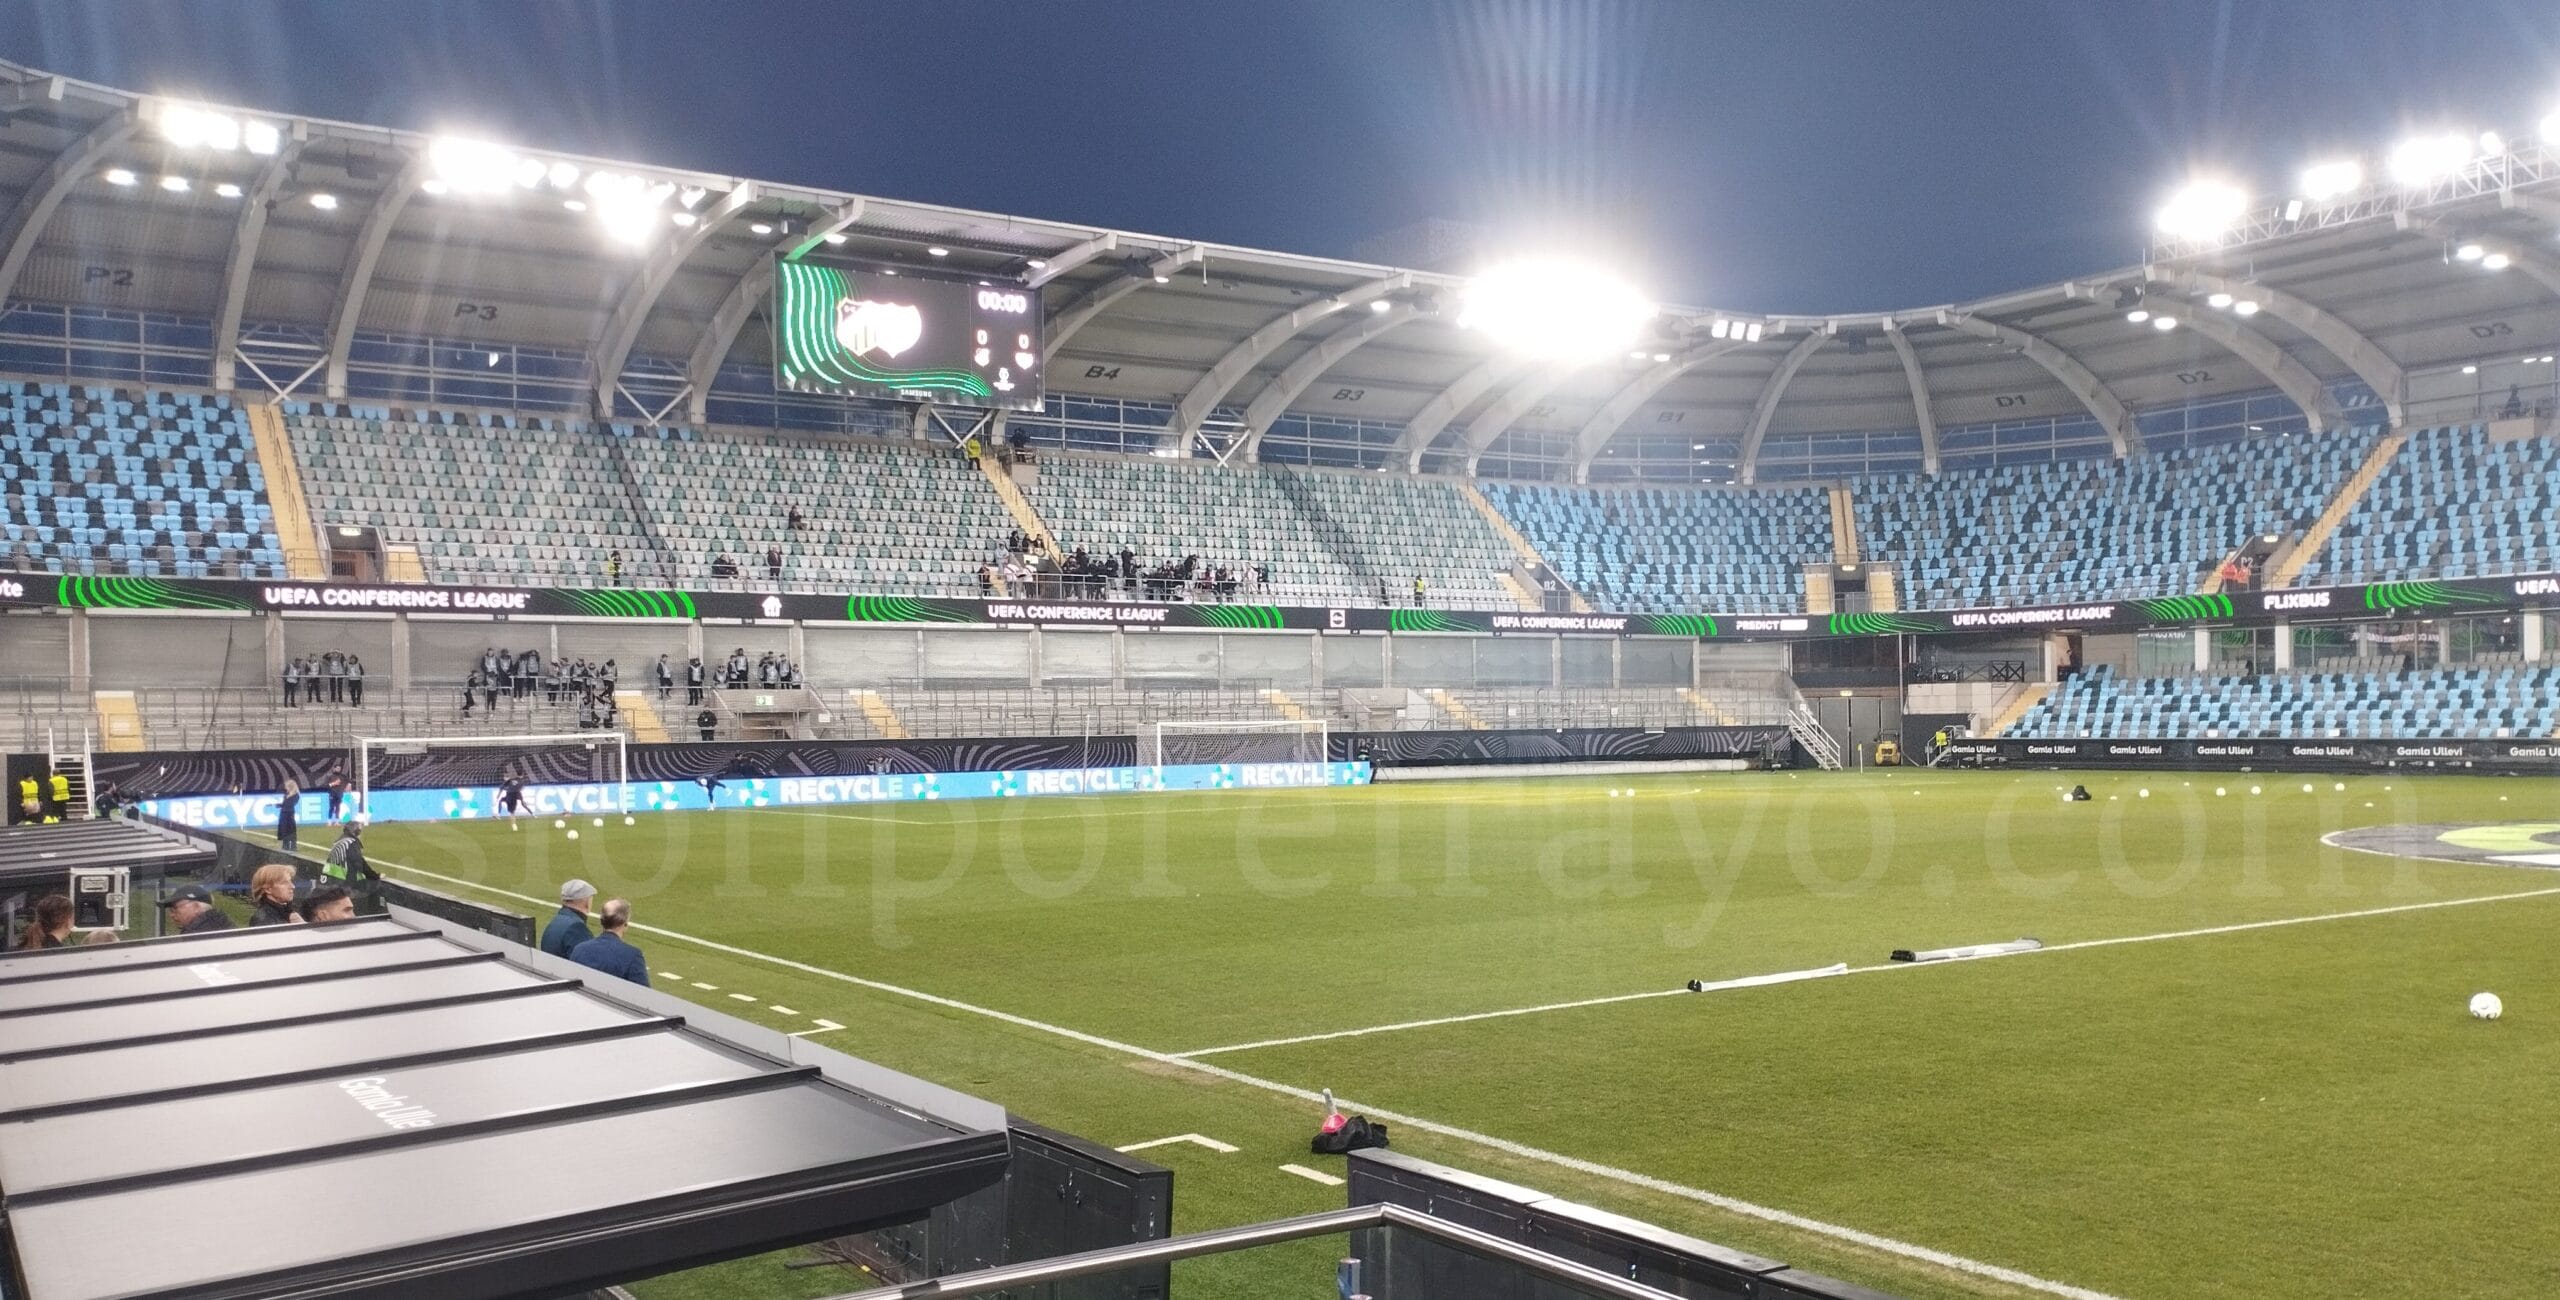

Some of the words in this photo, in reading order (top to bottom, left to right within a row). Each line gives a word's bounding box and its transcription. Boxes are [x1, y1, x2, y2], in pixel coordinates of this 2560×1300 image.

[84, 266, 134, 288] P2
[978, 291, 1026, 314] 00:00
[454, 303, 498, 321] P3
[977, 329, 988, 345] 0
[2469, 322, 2515, 340] D3
[1019, 333, 1030, 349] 0
[1084, 366, 1122, 379] B4
[2176, 370, 2214, 387] D2
[1332, 389, 1365, 401] B3
[1995, 394, 2027, 408] D1
[1656, 412, 1686, 424] B1
[2514, 578, 2560, 595] UEFA
[265, 587, 320, 605] UEFA
[322, 589, 450, 608] CONFERENCE
[988, 604, 1026, 619] UEFA
[1027, 605, 1114, 620] CONFERENCE
[1952, 613, 1987, 626] UEFA
[1988, 609, 2065, 625] CONFERENCE
[1492, 616, 1521, 628] UEFA
[1521, 617, 1586, 629] CONFERENCE
[1735, 620, 1780, 631] PREDICT
[1951, 745, 1976, 754] Gamla
[1976, 745, 1997, 754] Ullevi
[2027, 745, 2053, 754] Gamla
[2054, 745, 2076, 754] Ullevi
[2109, 745, 2137, 754] Gamla
[2137, 745, 2162, 754] Ullevi
[2197, 746, 2226, 755] Gamla
[2227, 746, 2254, 755] Ullevi
[2292, 746, 2325, 756] Gamla
[2325, 746, 2354, 756] Ullevi
[2396, 746, 2431, 756] Gamla
[2432, 746, 2463, 757] Ullevi
[2510, 746, 2546, 757] Gamla
[1027, 769, 1134, 793] RECYCLE
[1242, 764, 1336, 786] RECYCLE
[780, 777, 904, 802] RECYCLE
[170, 796, 322, 827] RECYCE
